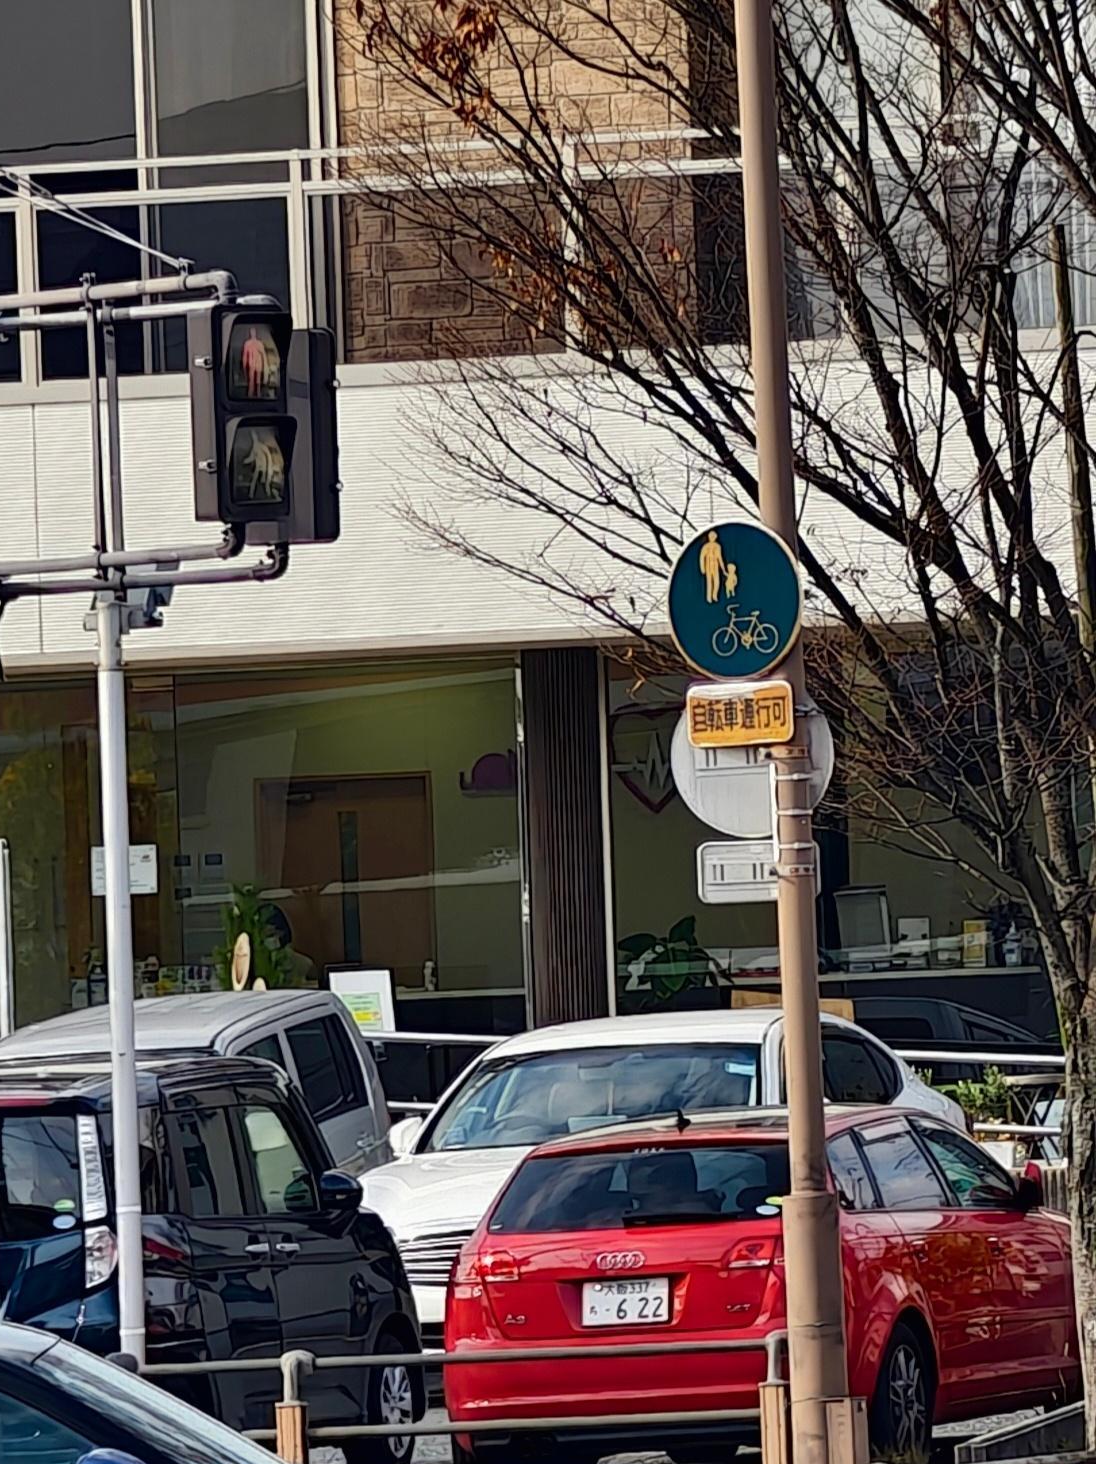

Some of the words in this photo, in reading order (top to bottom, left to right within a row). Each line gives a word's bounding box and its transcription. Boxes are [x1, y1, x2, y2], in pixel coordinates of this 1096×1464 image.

[693, 695, 786, 733] 自転車通行可
